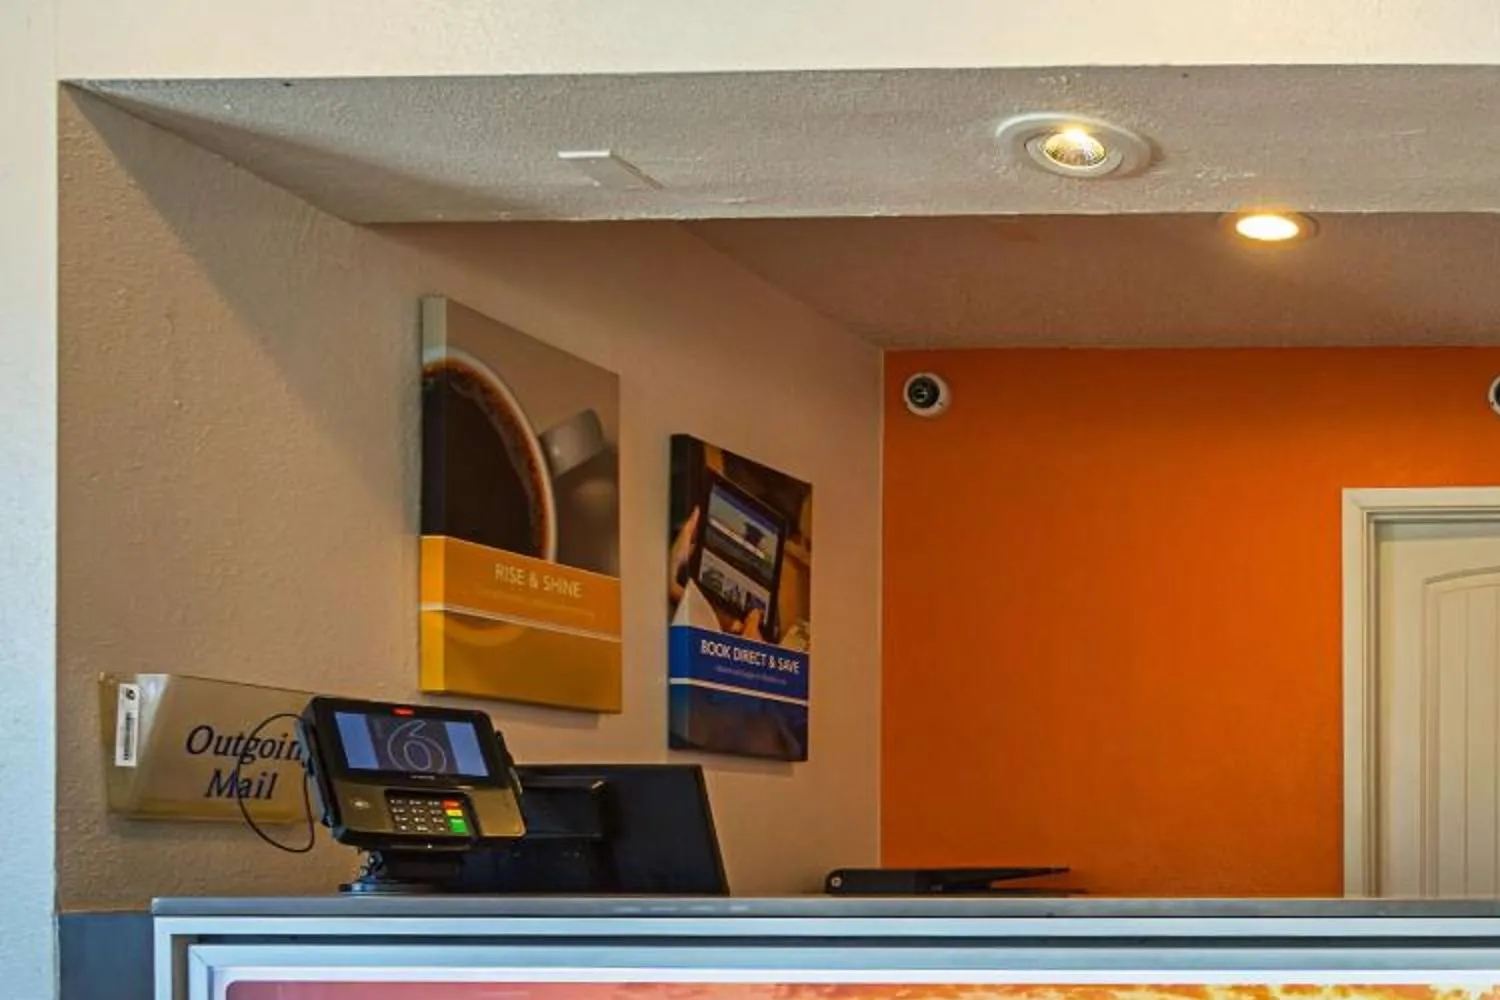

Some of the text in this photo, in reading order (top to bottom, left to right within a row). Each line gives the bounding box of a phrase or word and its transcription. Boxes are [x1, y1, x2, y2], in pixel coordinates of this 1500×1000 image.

[494, 563, 583, 599] RISE & SHINE
[701, 640, 800, 675] BOOK DIRECT & SAVE
[186, 724, 306, 769] Outgoin
[204, 768, 279, 801] Mail
